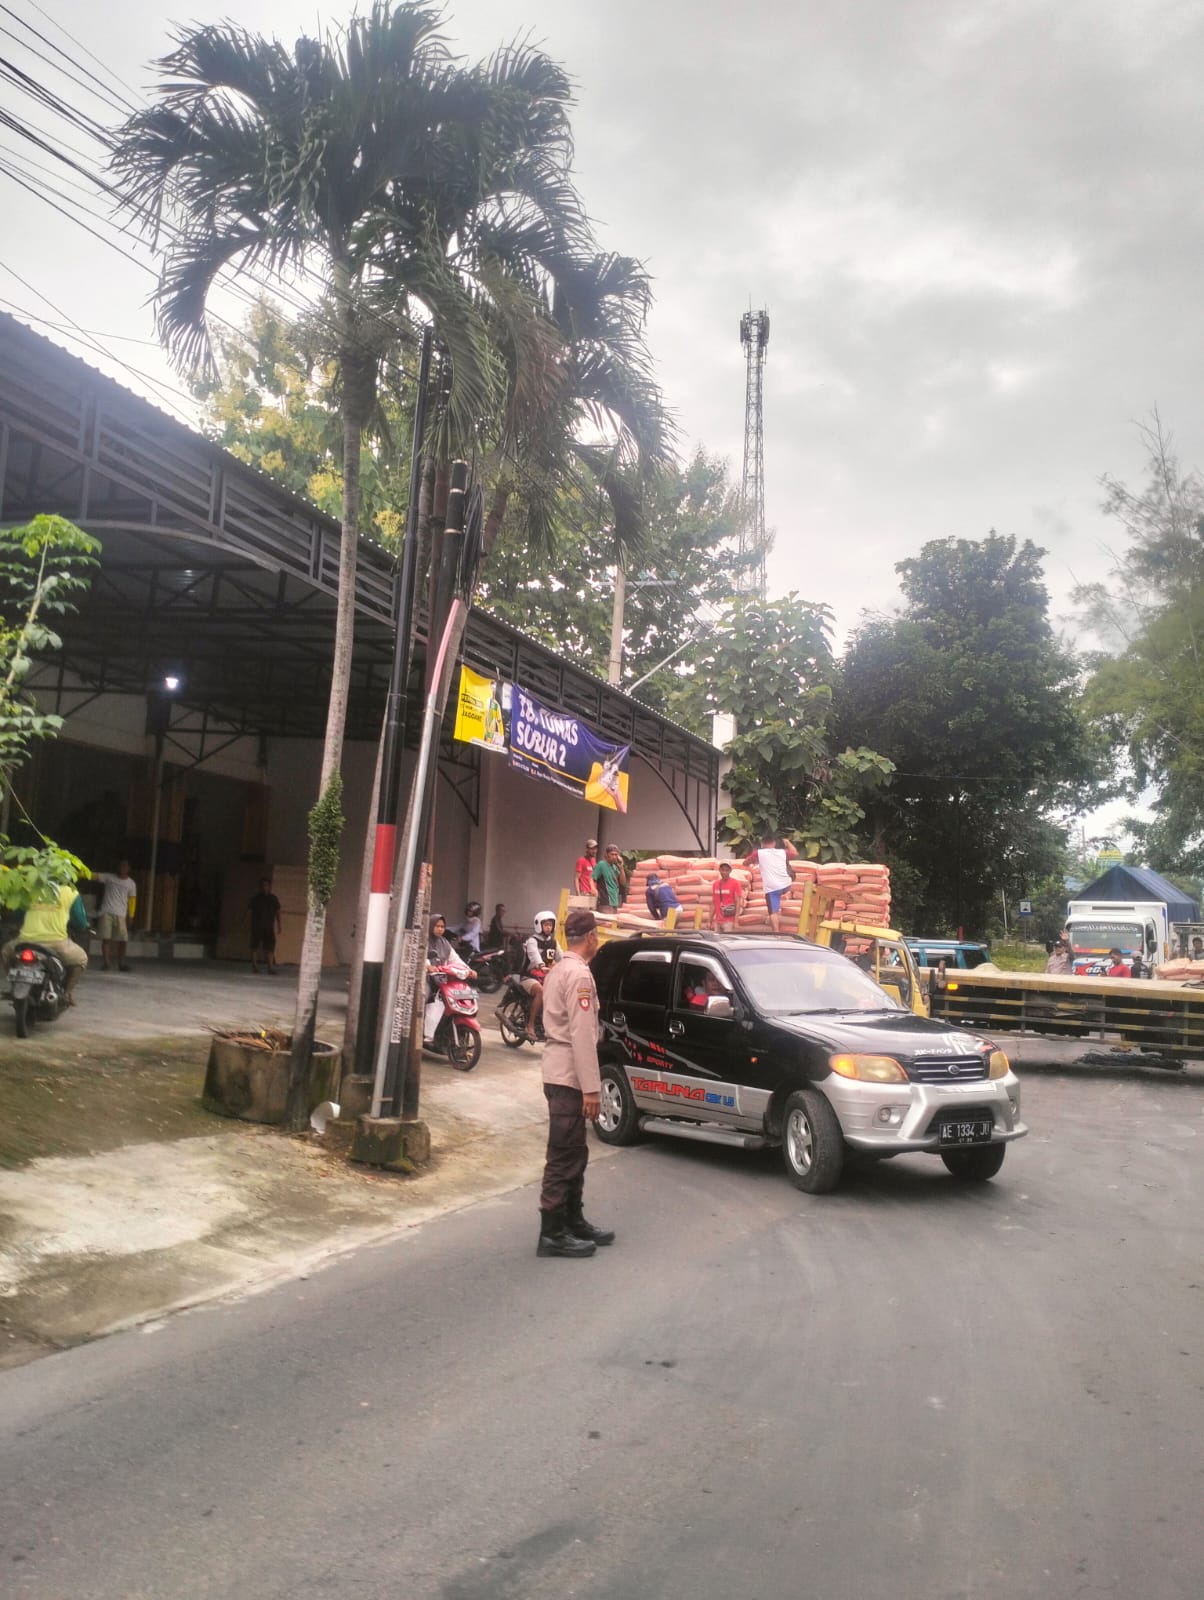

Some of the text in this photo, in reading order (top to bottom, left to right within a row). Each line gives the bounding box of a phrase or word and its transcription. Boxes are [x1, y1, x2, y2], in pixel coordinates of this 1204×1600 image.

[539, 709, 579, 746] TUNAS
[559, 746, 567, 768] 2
[631, 1076, 706, 1102] TARUNA
[942, 1125, 953, 1139] AE
[957, 1123, 975, 1137] 1334
